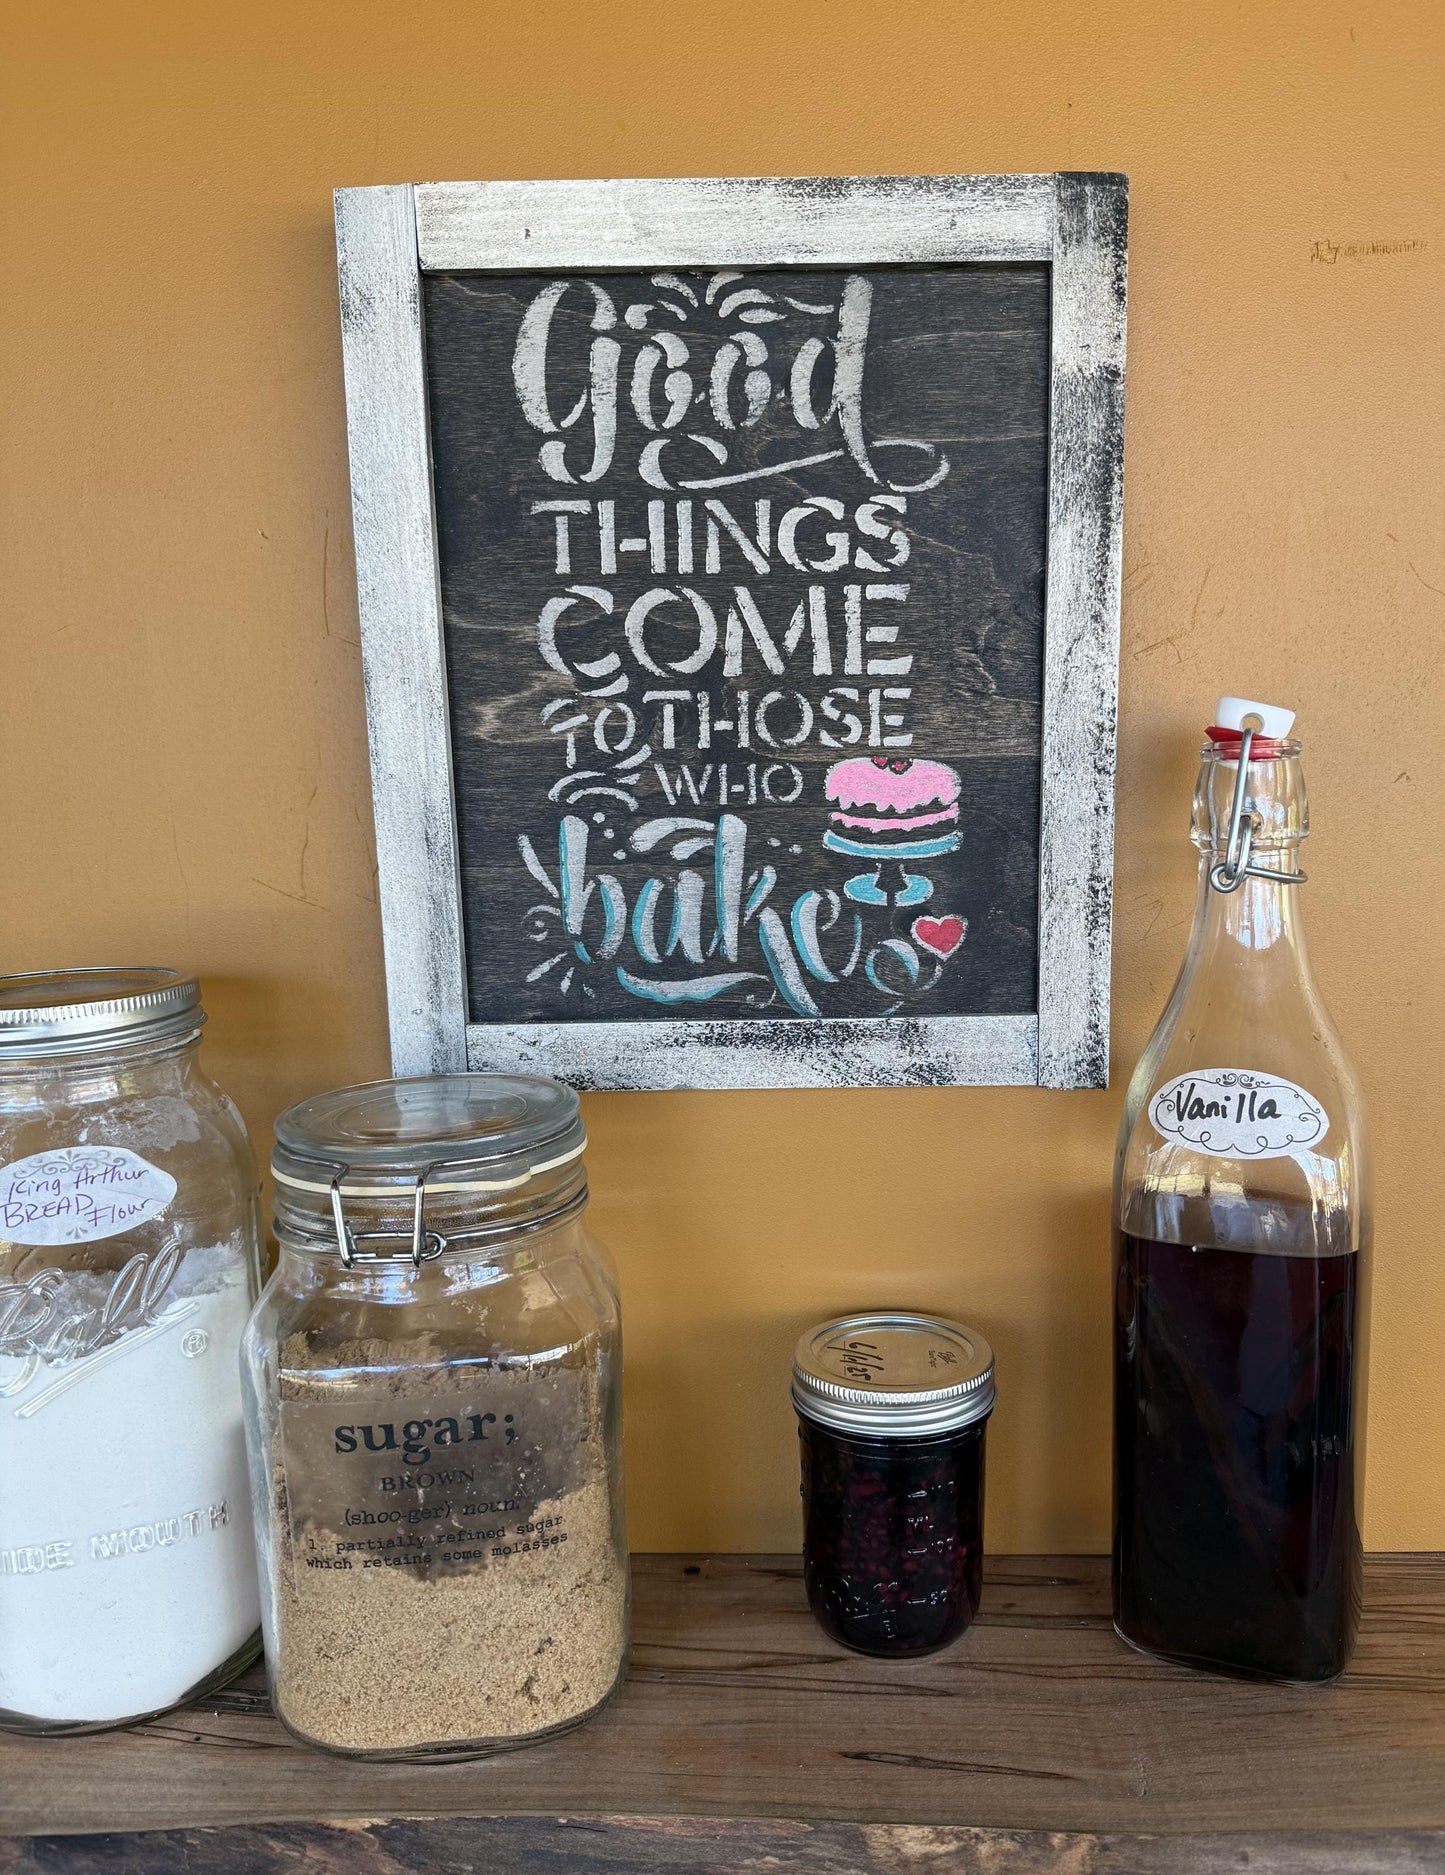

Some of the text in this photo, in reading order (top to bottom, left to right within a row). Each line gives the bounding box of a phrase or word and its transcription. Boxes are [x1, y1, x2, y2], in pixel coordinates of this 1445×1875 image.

[512, 275, 950, 492] good
[531, 495, 911, 575] THINGS
[537, 585, 914, 677] COME
[540, 688, 914, 768] TO THOSE
[654, 763, 805, 805] WHO
[558, 814, 866, 1016] bake
[1176, 1083, 1282, 1124] Vanilla
[8, 1165, 150, 1203] King Arthur
[0, 1193, 154, 1228] BREAD Flour
[334, 1411, 515, 1466] sugar;
[380, 1469, 476, 1493] BROWN
[308, 1514, 564, 1555] 1. partially refined sugar
[344, 1503, 452, 1527] (shoo-ger)
[0, 1501, 231, 1574] IDE MOUTH
[306, 1531, 569, 1571] which retains some molasses
